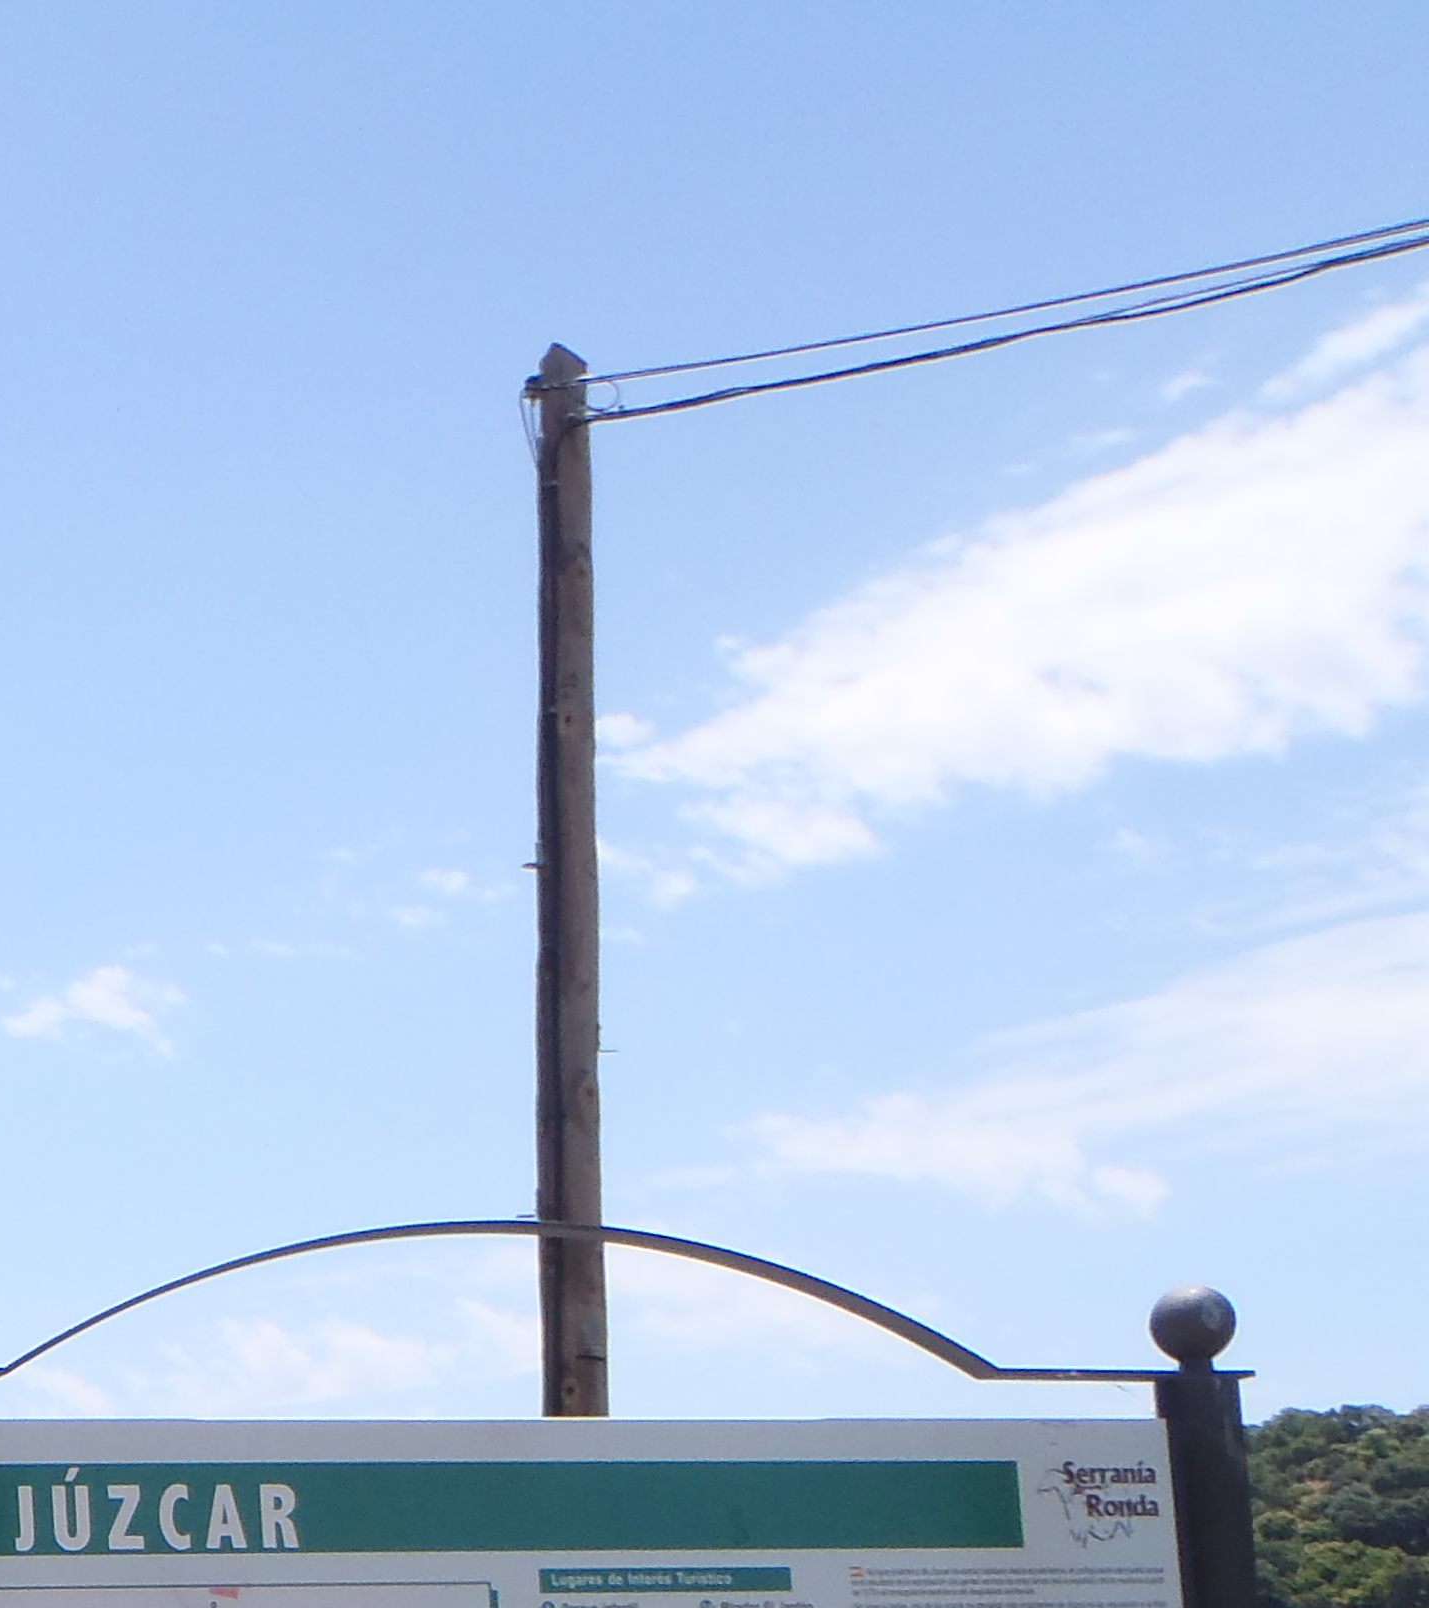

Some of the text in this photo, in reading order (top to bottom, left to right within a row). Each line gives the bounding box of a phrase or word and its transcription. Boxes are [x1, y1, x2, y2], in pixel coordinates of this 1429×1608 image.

[1062, 1460, 1156, 1484] Serranía
[15, 1467, 299, 1551] JÚZCAR
[1086, 1494, 1159, 1516] Ronda
[551, 1573, 602, 1588] Lugares
[607, 1573, 623, 1585] de
[628, 1572, 672, 1585] Interés
